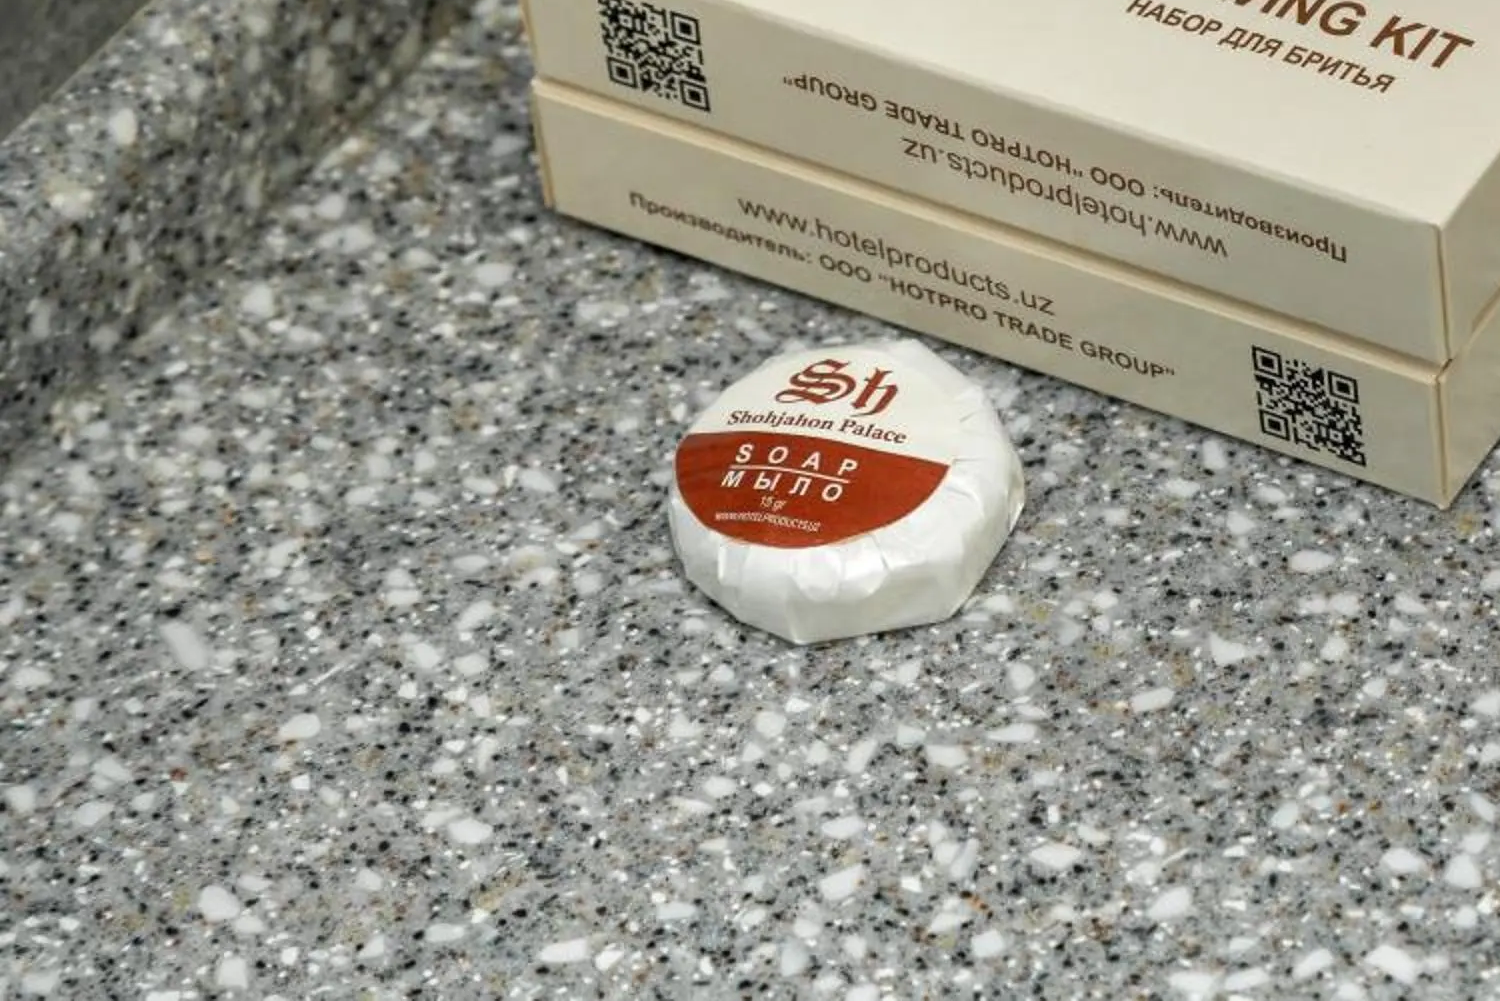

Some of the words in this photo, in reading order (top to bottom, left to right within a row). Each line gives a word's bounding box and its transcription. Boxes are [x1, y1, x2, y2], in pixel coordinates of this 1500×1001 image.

[1219, 27, 1284, 58] ДЛЯ
[1282, 46, 1396, 94] БРИТЬЯ
[1370, 15, 1474, 70] KIT
[884, 99, 966, 141] TRADE
[901, 136, 1230, 259] www.hotelproducts.uz
[1153, 185, 1348, 263] Производитель:
[628, 191, 813, 265] Производитель:
[992, 309, 1075, 351] TRADE
[737, 198, 1057, 317] www.hotelproducts.uz
[726, 409, 834, 432] Shohjahon
[838, 418, 908, 445] Palace
[720, 470, 844, 503] МЫЛО
[735, 443, 857, 475] SOAP
